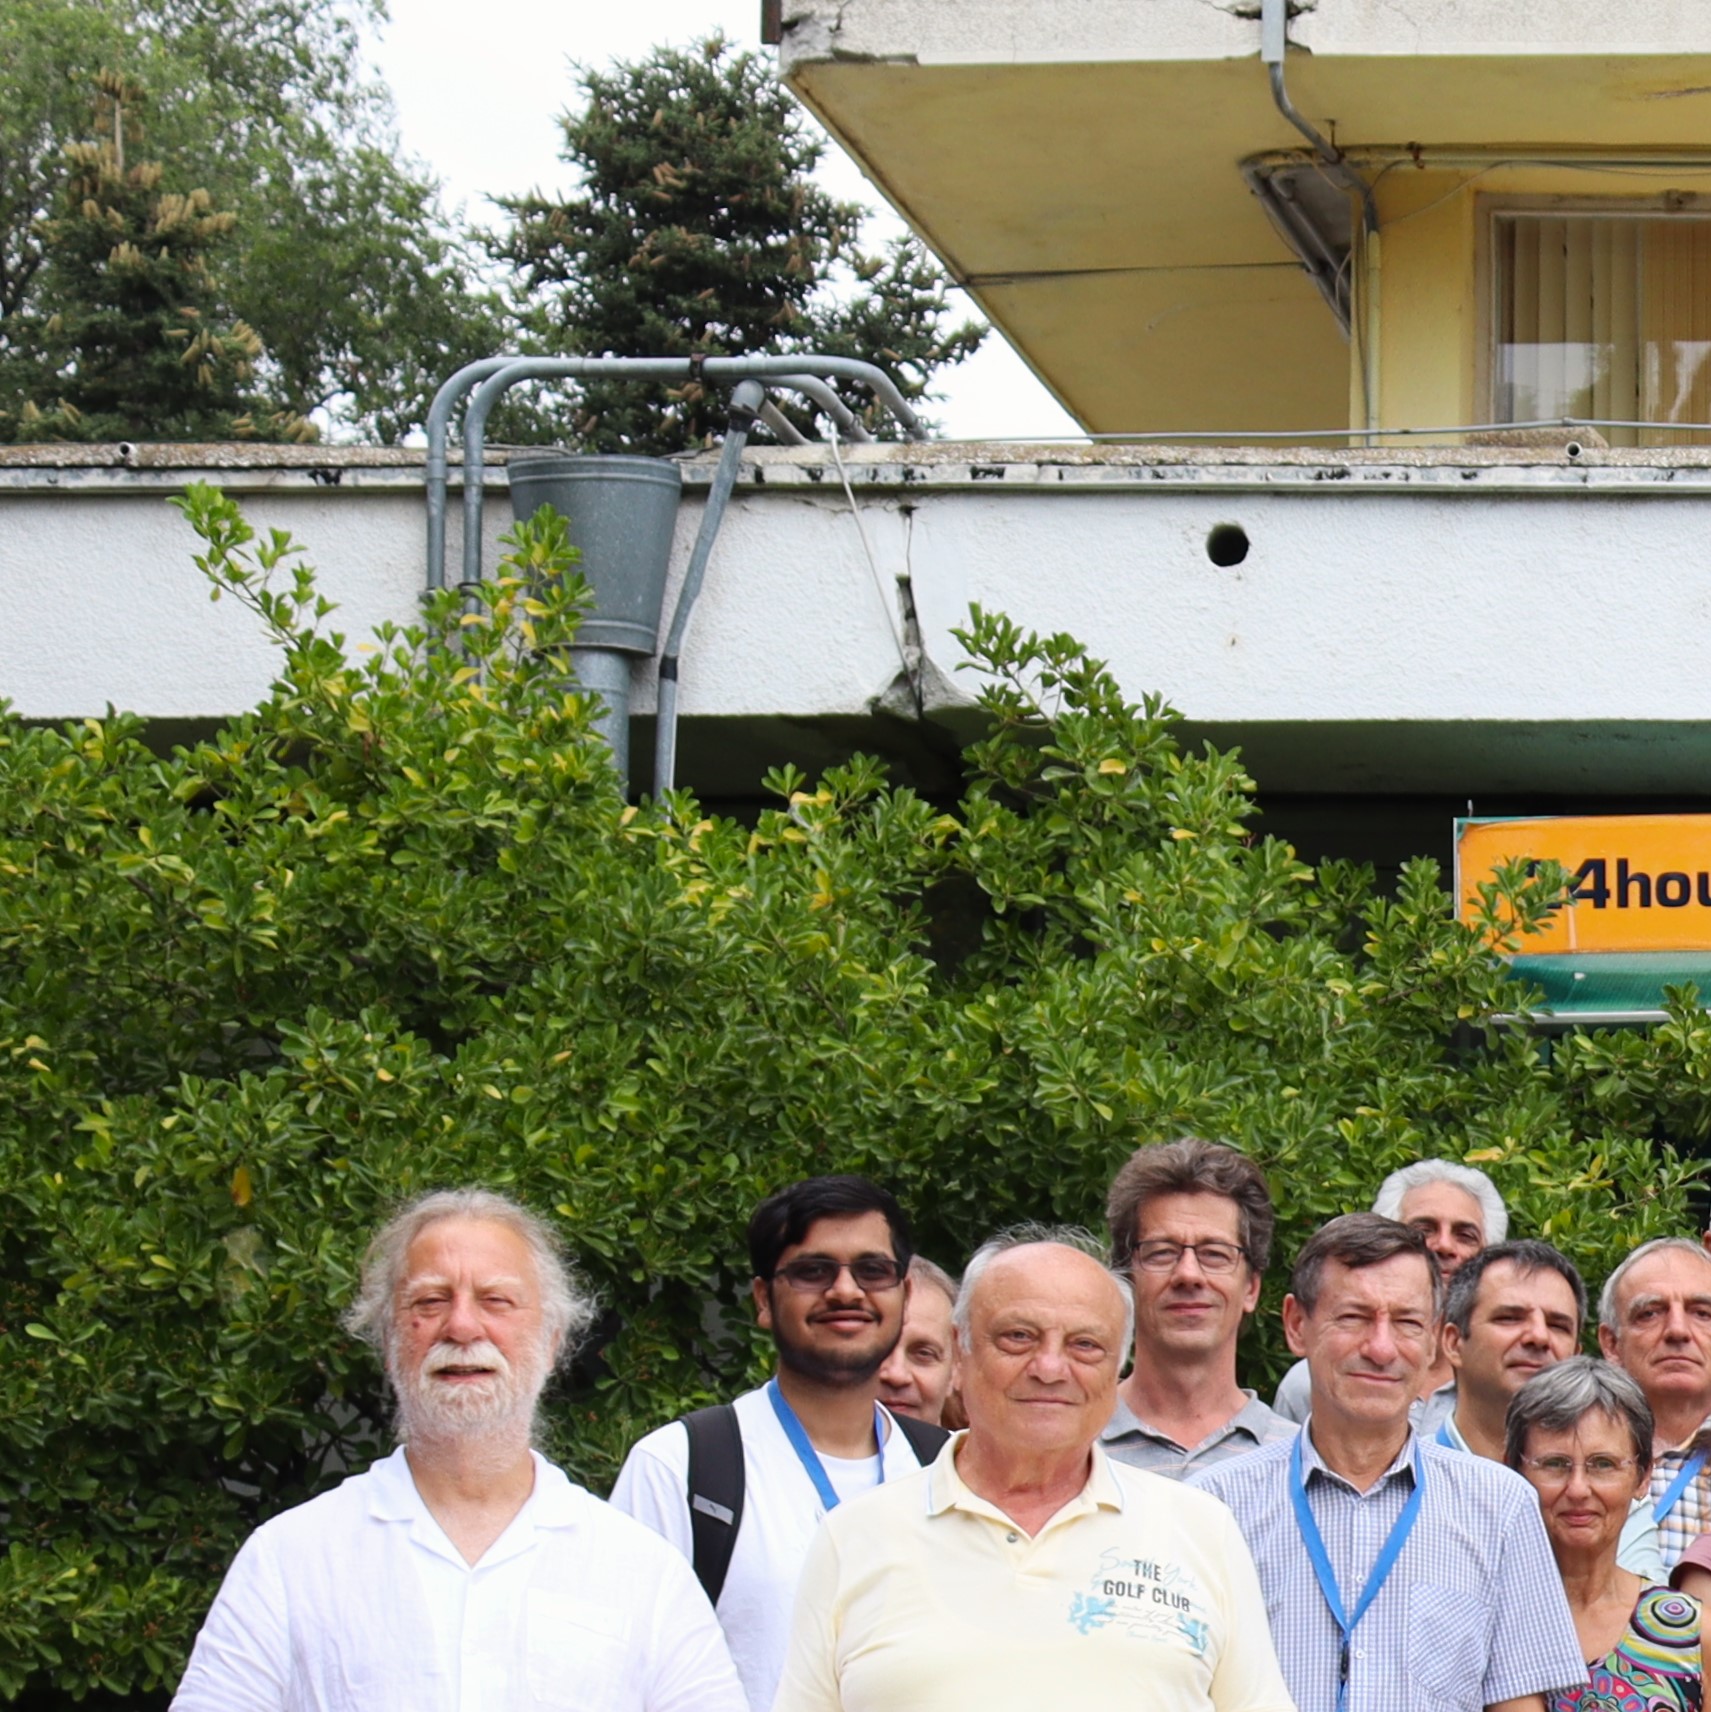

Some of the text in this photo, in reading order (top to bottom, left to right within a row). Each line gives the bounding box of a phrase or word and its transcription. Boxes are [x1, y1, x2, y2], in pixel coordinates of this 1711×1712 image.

[1132, 1558, 1163, 1583] THE
[1102, 1578, 1147, 1600] GOLF
[1151, 1585, 1192, 1613] CLUB
